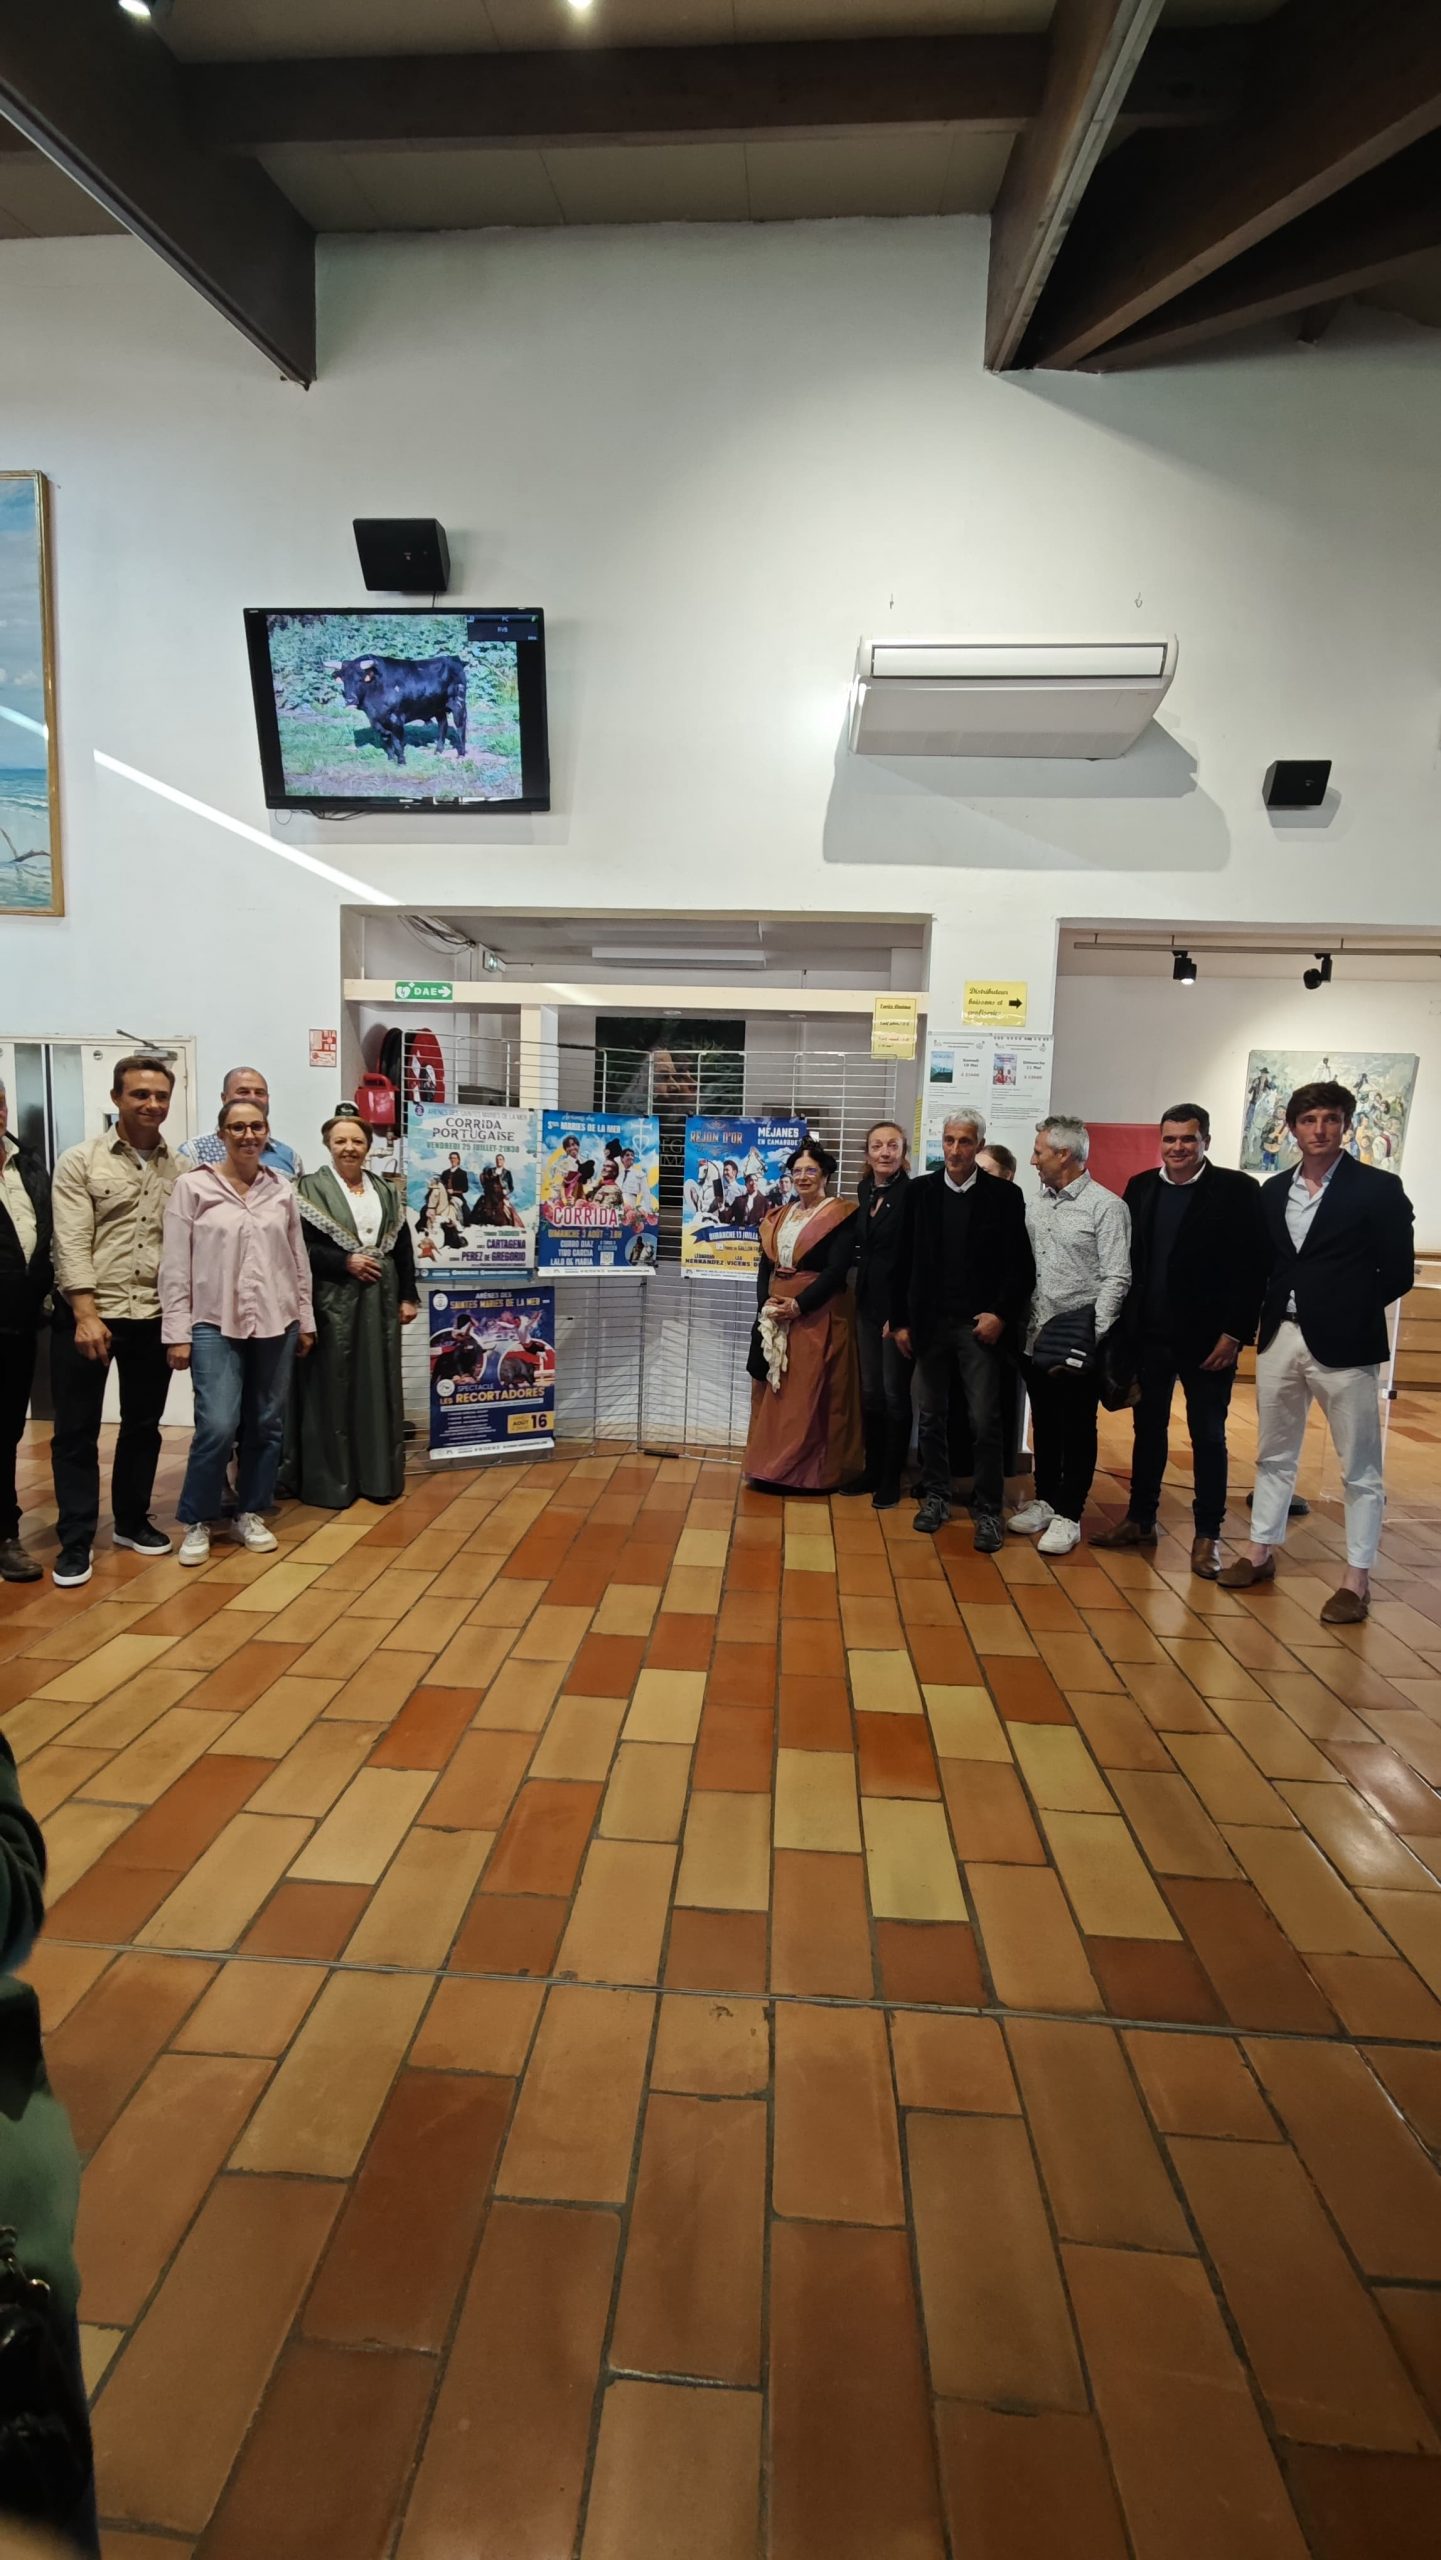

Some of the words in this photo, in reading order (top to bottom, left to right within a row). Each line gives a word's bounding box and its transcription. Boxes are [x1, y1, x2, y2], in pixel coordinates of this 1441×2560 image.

[413, 987, 438, 996] DAE
[560, 1122, 586, 1131] MARIES
[587, 1123, 596, 1132] DE
[597, 1124, 605, 1132] LA
[606, 1124, 621, 1134] MER
[722, 1132, 743, 1144] D'OR
[757, 1138, 765, 1146] EN
[426, 1142, 460, 1150] VENDREDI
[553, 1207, 618, 1226] CORRIDA
[709, 1231, 735, 1240] DIMANCHE
[486, 1239, 526, 1249] CARTAGENA
[461, 1251, 483, 1262] PEREZ
[492, 1251, 526, 1262] GREGORIO
[685, 1258, 724, 1266] HERNANDEZ
[449, 1300, 478, 1310] SAINTES
[480, 1299, 504, 1308] MARIES
[505, 1298, 514, 1307] DE
[516, 1298, 525, 1306] LA
[457, 1383, 495, 1392] SPECTACLE
[455, 1387, 545, 1404] RECORTADORES
[531, 1413, 548, 1429] 16
